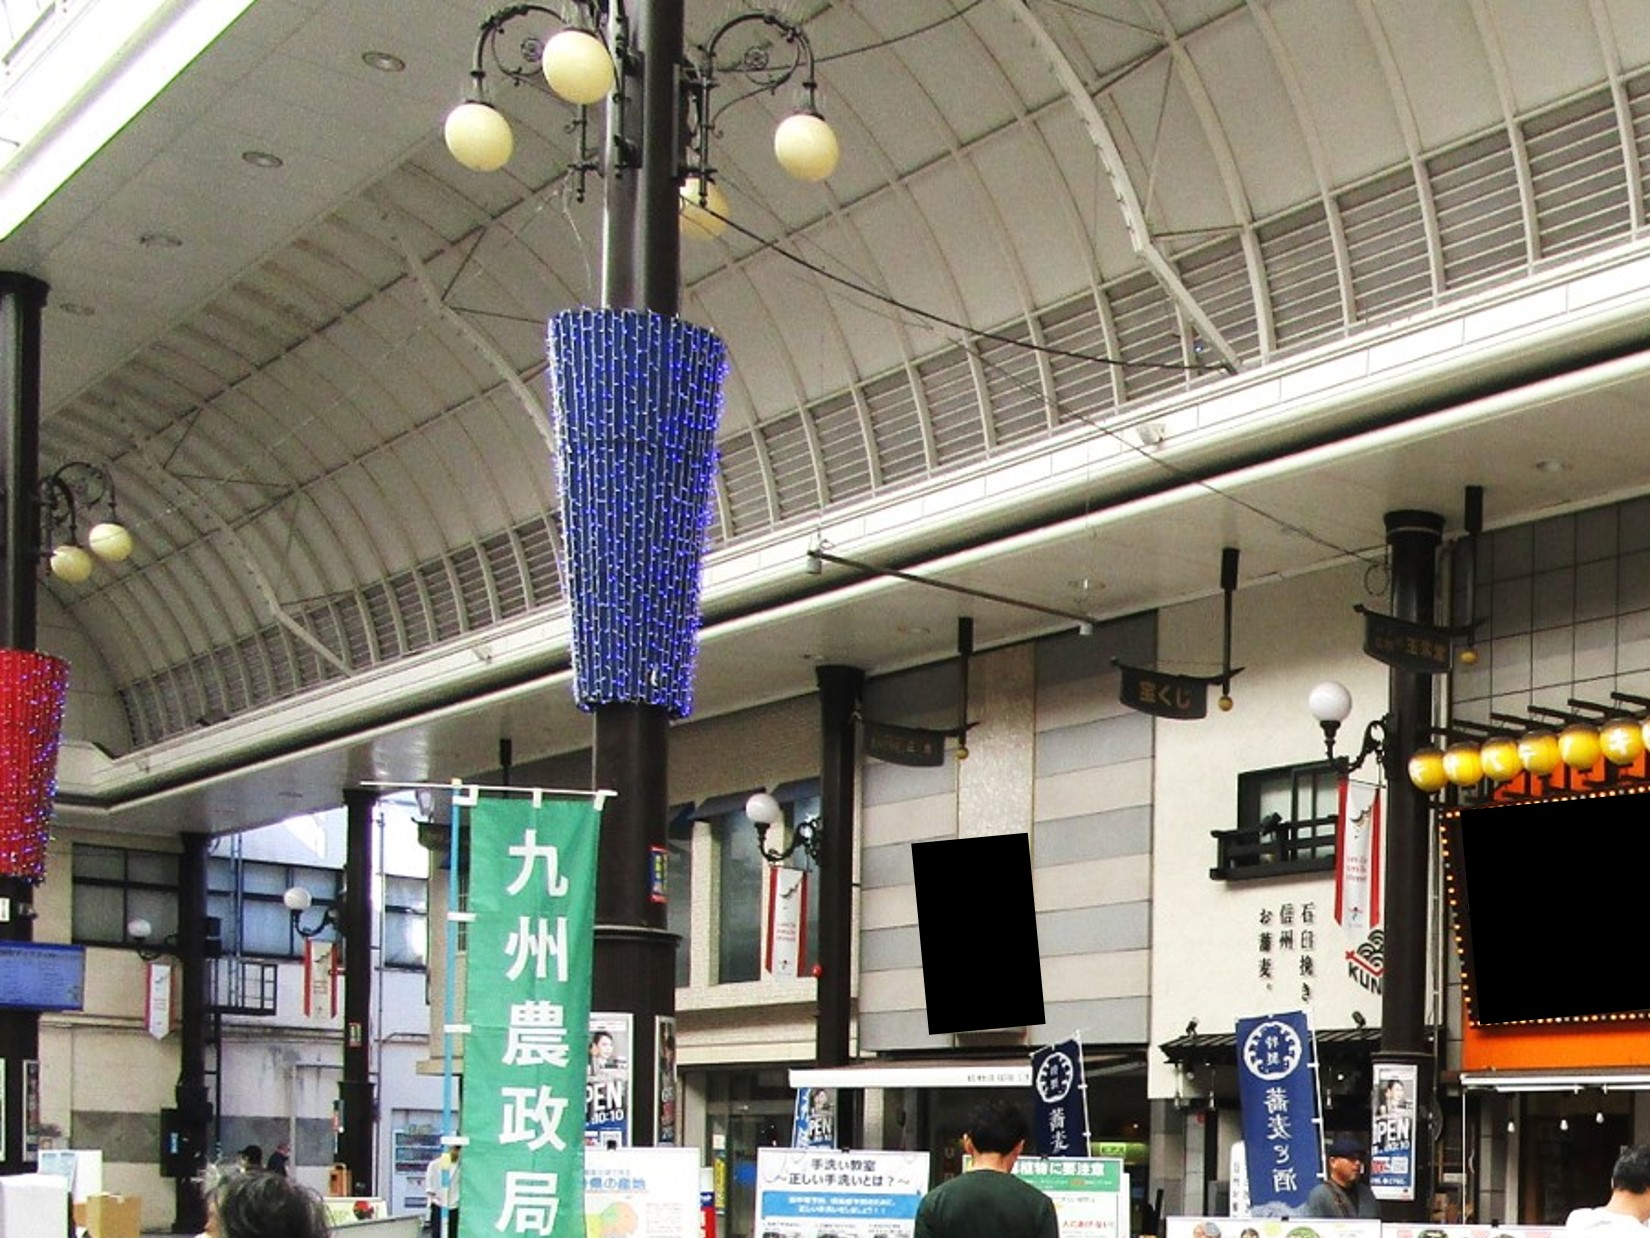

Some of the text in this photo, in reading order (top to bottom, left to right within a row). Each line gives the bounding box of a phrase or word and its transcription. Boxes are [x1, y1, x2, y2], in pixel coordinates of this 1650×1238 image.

[1138, 680, 1192, 710] 宝くじ
[1279, 903, 1294, 950] 信州
[495, 828, 571, 1238] 九州農政局
[811, 1159, 876, 1172] 手洗い教室
